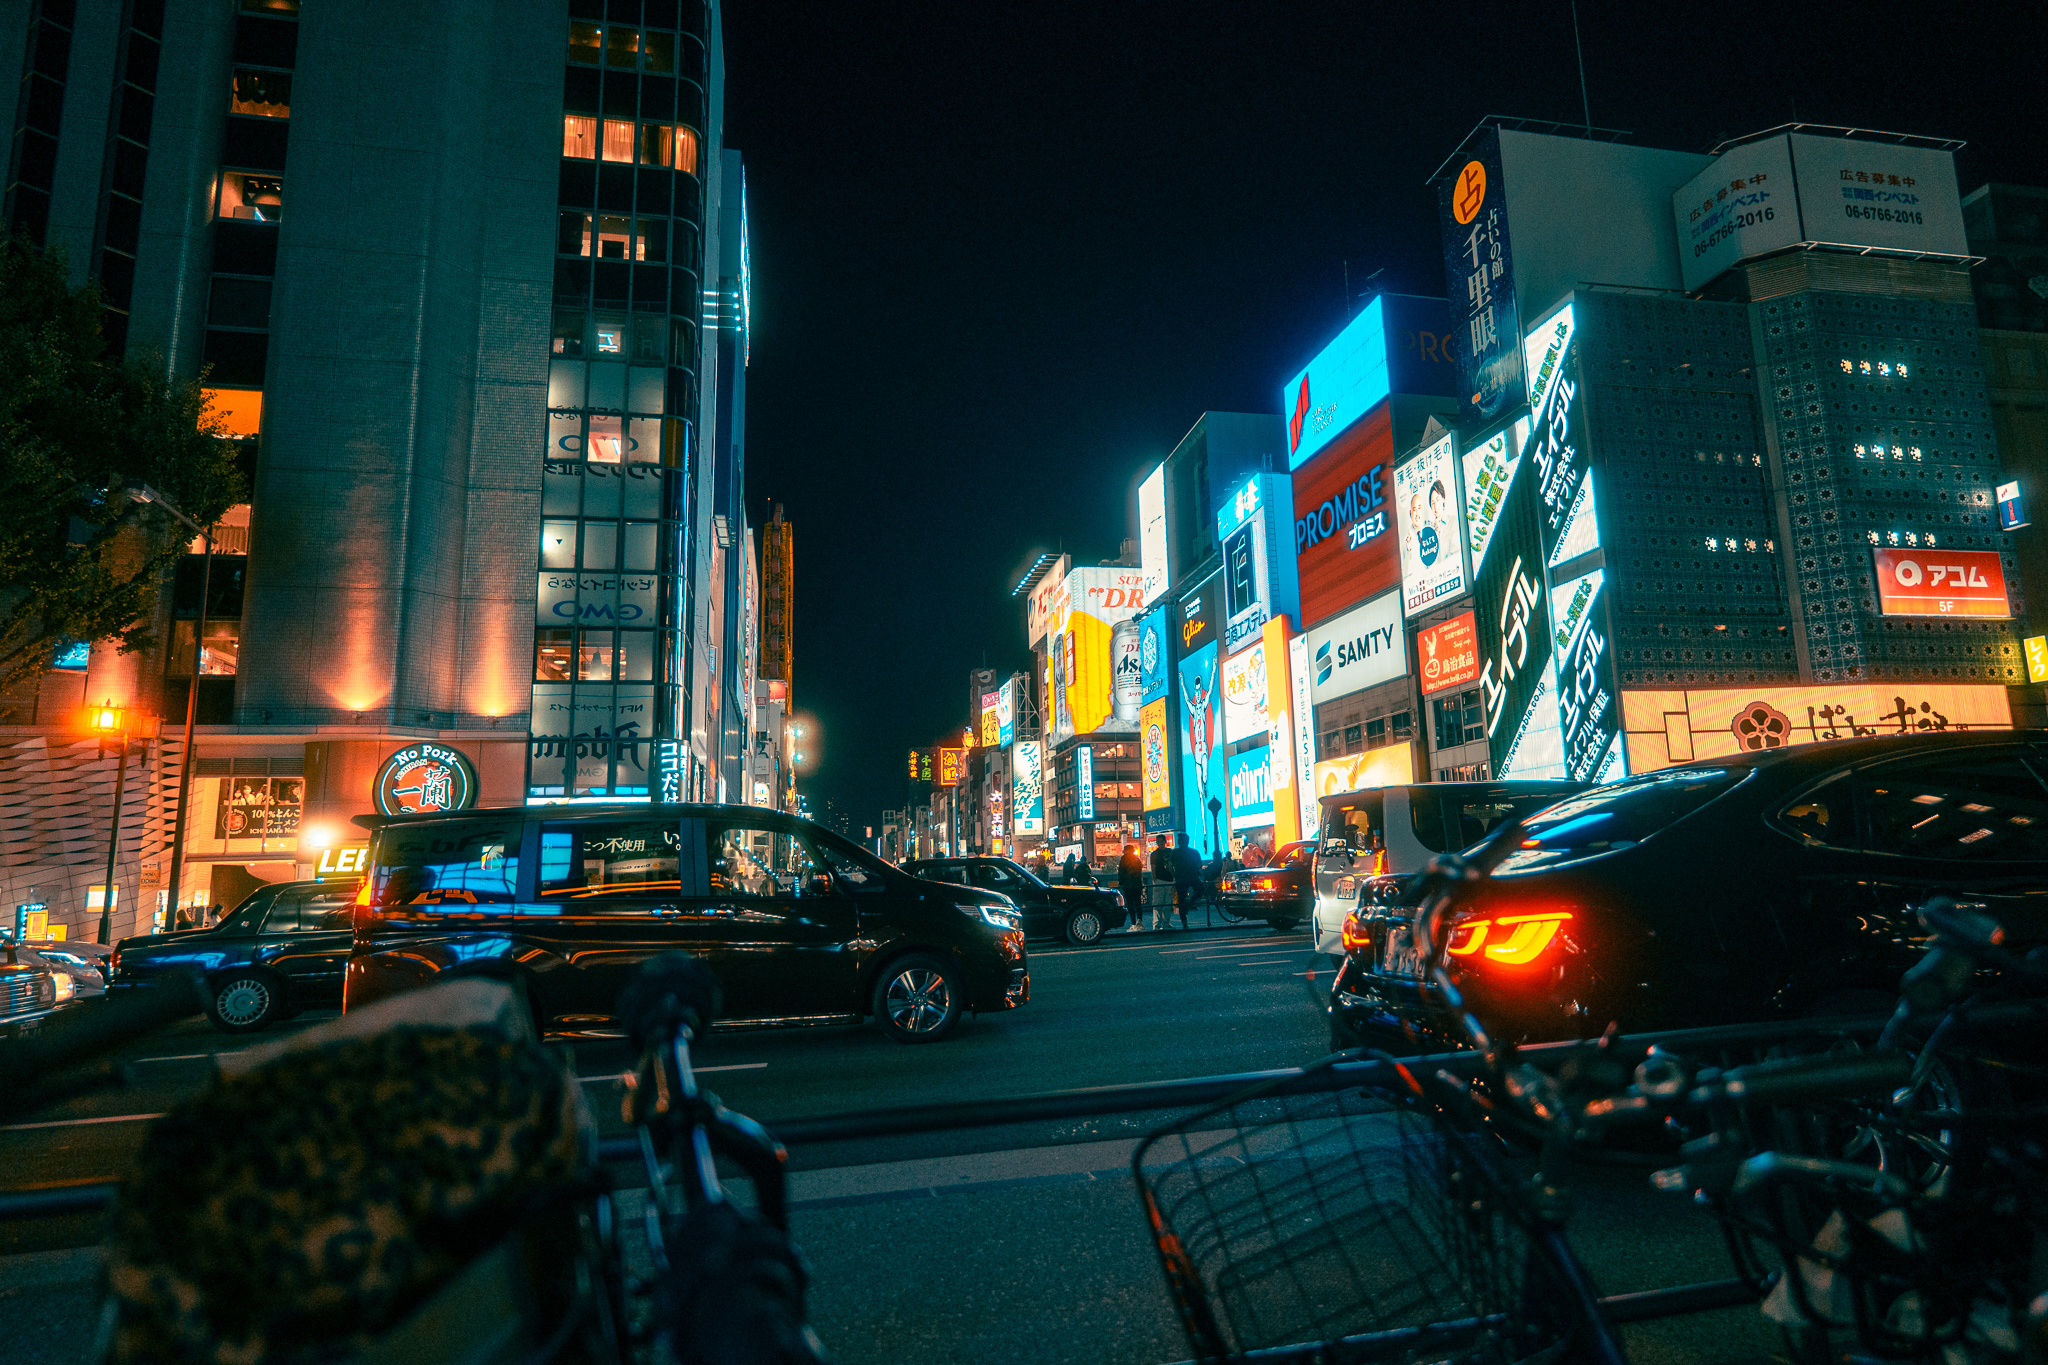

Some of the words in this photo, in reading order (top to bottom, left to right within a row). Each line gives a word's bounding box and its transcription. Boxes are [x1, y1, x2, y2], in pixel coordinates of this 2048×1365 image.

[1460, 169, 1481, 221] 占
[1689, 173, 1767, 224] 広告募集中
[1840, 169, 1916, 188] 広告募集中
[1694, 207, 1775, 258] 06-6766-2016
[1845, 204, 1923, 225] 06-6766-2016
[1487, 208, 1504, 280] 占いの館
[1462, 223, 1497, 357] 千里眼
[1530, 321, 1568, 408] お部屋探しは
[1532, 377, 1576, 480] エイブル
[1466, 437, 1503, 522] いい暮らし
[1544, 445, 1576, 507] 株式会社
[1548, 469, 1577, 529] エイブル
[1296, 464, 1383, 555] PROMISE
[1348, 511, 1385, 550] プロミス
[1470, 465, 1509, 552] いい部屋で
[1552, 488, 1586, 562] www.able.co.jp
[1926, 565, 1989, 588] アコム
[1939, 601, 1954, 612] 5F
[1183, 619, 1206, 648] Glico
[1337, 623, 1394, 668] SAMTY
[1478, 570, 1542, 713] エイブル
[2029, 640, 2046, 677] レイク
[1559, 628, 1605, 726] エイブル
[395, 750, 418, 765] No
[422, 745, 457, 765] Pork
[1566, 687, 1610, 772] エイブル保証
[1574, 728, 1607, 782] 株式会社
[392, 766, 452, 810] 一蘭
[394, 758, 428, 782] ICHIRAN
[267, 819, 300, 827] ラーメン
